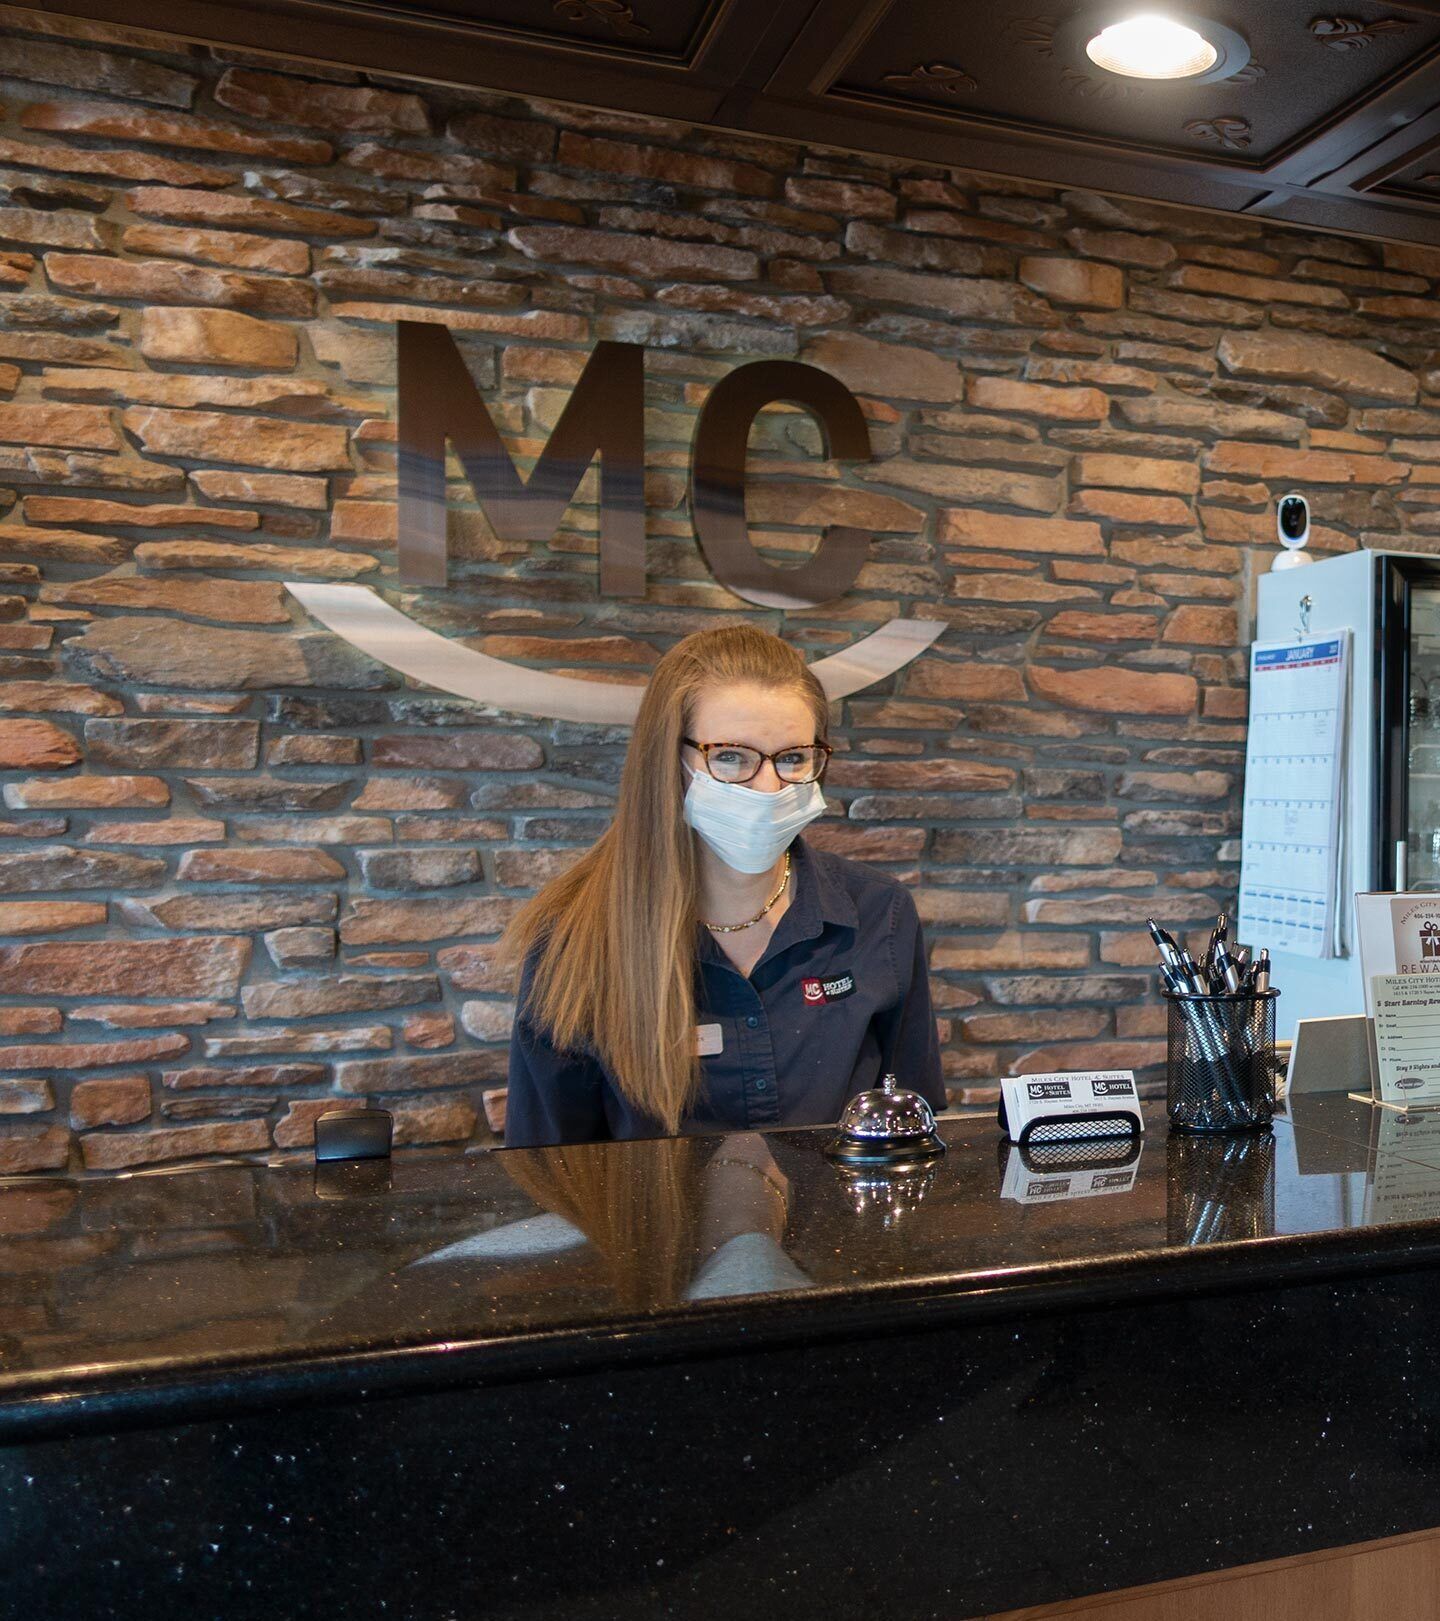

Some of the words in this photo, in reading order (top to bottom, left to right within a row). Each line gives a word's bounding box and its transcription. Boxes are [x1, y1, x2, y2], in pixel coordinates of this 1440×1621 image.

[396, 320, 871, 609] MC
[1400, 905, 1419, 925] MILES
[805, 983, 821, 995] MC
[823, 977, 853, 991] HOTEL
[1030, 1085, 1042, 1094] MC
[1094, 1082, 1107, 1090] MC
